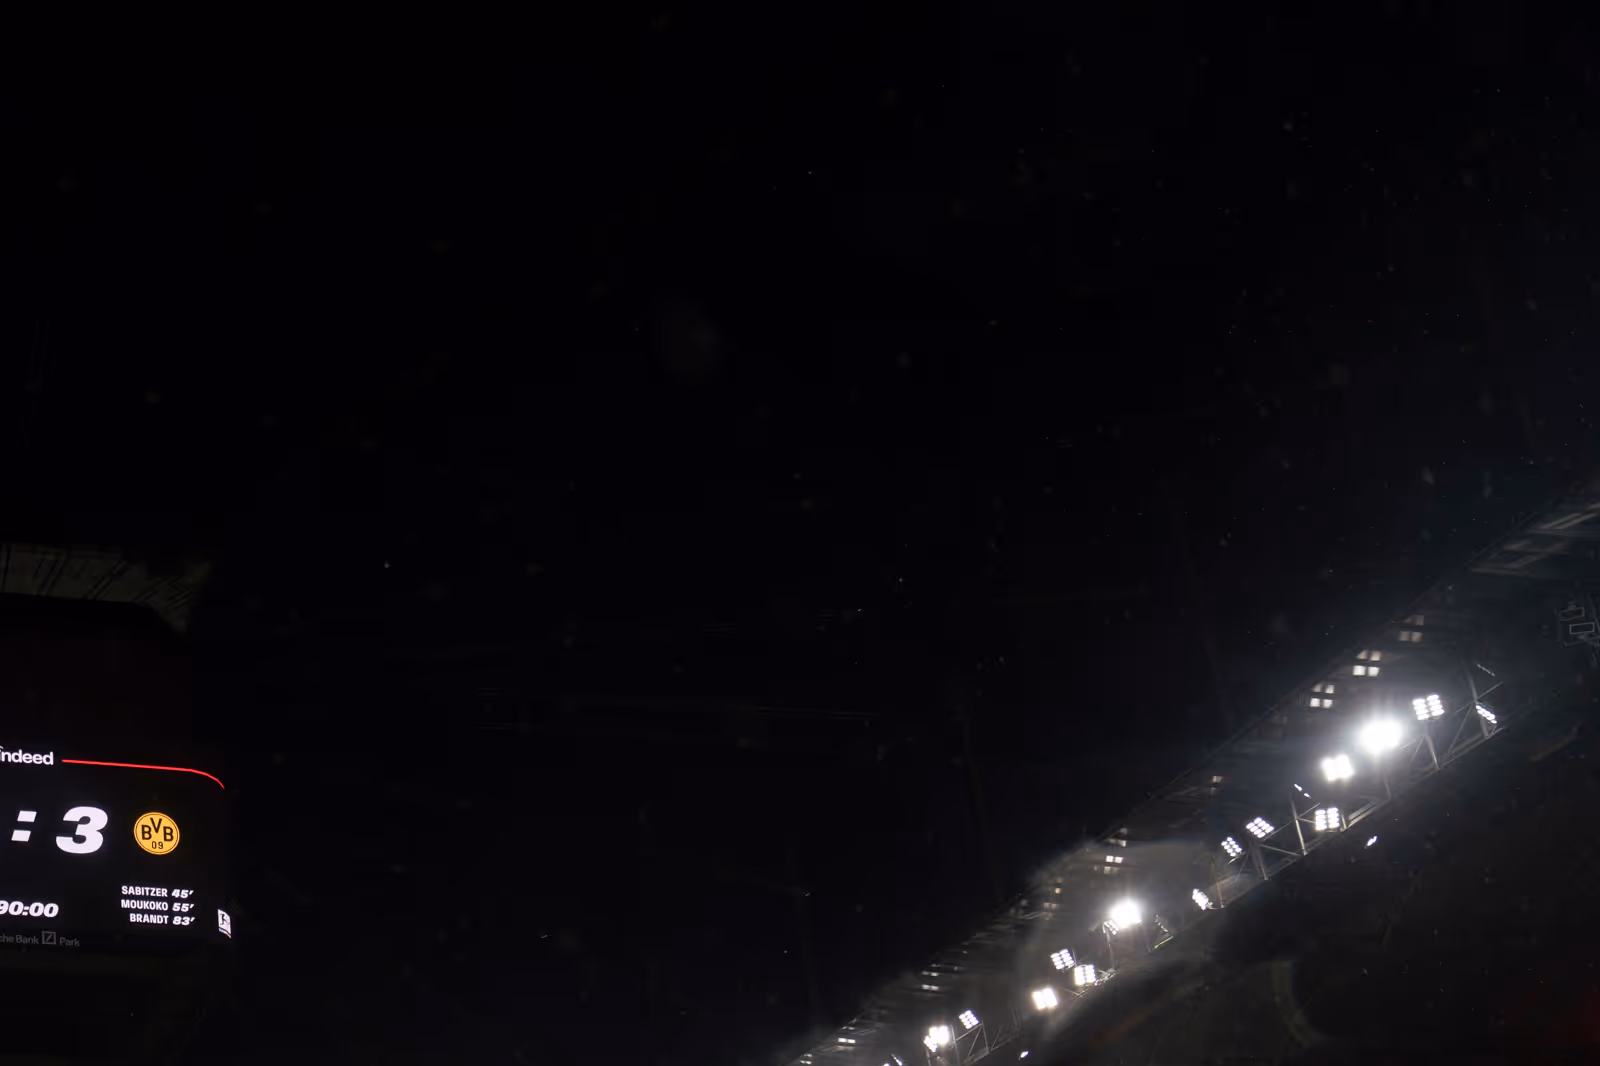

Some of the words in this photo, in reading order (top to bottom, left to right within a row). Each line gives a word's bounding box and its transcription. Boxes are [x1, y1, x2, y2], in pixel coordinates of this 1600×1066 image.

[56, 806, 108, 854] 3
[141, 818, 174, 842] BVB
[151, 841, 164, 850] 09
[121, 885, 168, 897] SABITZER
[121, 899, 168, 911] MOUKOKO
[129, 913, 169, 924] BRANDT
[15, 934, 40, 945] Bank
[59, 937, 81, 947] Park
